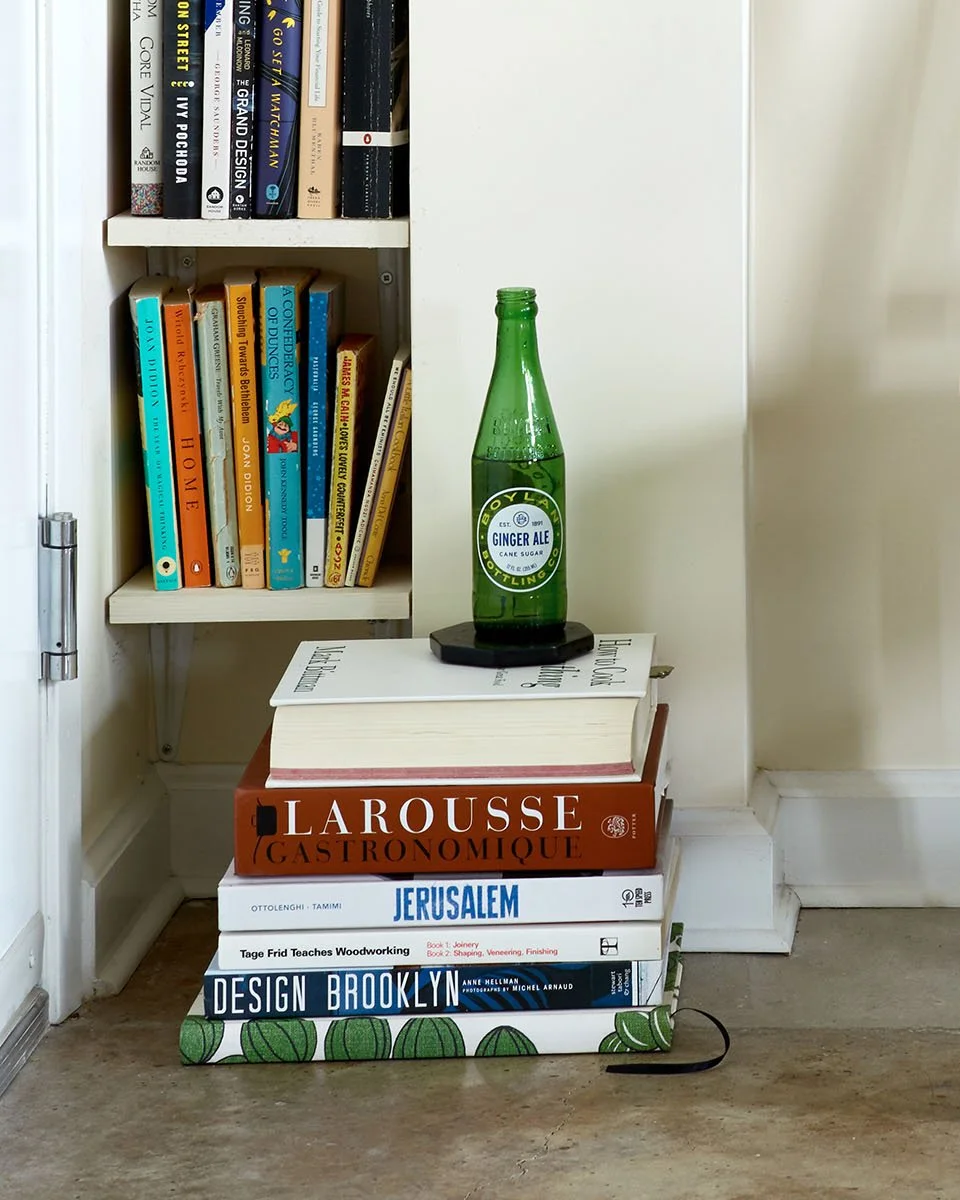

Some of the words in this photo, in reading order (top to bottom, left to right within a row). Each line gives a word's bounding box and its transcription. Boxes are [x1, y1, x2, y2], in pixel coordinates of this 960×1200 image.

[176, 23, 189, 72] STREET
[272, 28, 283, 46] GO
[314, 25, 322, 47] Starting
[139, 36, 154, 79] GORE
[271, 50, 283, 75] SET
[271, 78, 281, 87] A
[313, 63, 321, 89] Financial
[140, 84, 154, 131] VIDAL
[176, 97, 189, 119] IVY
[235, 88, 249, 135] GRAND
[269, 93, 281, 169] WATCHMAN
[175, 124, 188, 184] POCHODA
[234, 139, 247, 189] DESIGN
[282, 287, 292, 297] A
[175, 309, 184, 345] Witold
[211, 308, 221, 341] GRAHAM
[236, 296, 246, 338] Slouching
[267, 306, 279, 324] OF
[145, 318, 155, 352] JOAN
[282, 299, 295, 396] CONFEDERACY
[213, 342, 221, 371] GREENE
[238, 340, 249, 376] Towards
[267, 326, 279, 380] DUNCES
[148, 359, 160, 408] DIDION
[176, 351, 189, 413] Rybczynski
[341, 356, 352, 386] JAMES
[240, 379, 250, 424] Bethlehem
[341, 388, 350, 399] M.
[388, 377, 398, 401] SHOULD
[340, 400, 350, 424] CAIN
[242, 438, 250, 468] JOAN
[376, 424, 387, 456] FEMINISTS
[387, 430, 404, 473] Cookbook
[181, 437, 199, 511] HOME
[279, 458, 287, 477] JOHN
[338, 453, 348, 481] LOVELY
[367, 459, 379, 497] CHIMAMANDA
[156, 474, 164, 508] MAGICAL
[243, 473, 253, 512] DIDION
[335, 482, 346, 535] COUNTERFEIT
[481, 492, 560, 526] BOYLAN
[159, 511, 168, 551] THINKING
[492, 532, 530, 547] GINGER
[533, 530, 550, 546] ALE
[482, 550, 546, 586] BOTTLING
[308, 645, 347, 665] Mark
[594, 657, 621, 666] to
[598, 638, 632, 657] How
[294, 665, 337, 693] Bittman
[591, 666, 627, 686] Cook
[283, 795, 582, 836] LAROUSSE
[266, 836, 583, 865] GASTRONOMIQUE
[251, 903, 305, 912] OTTOLENGHI
[312, 902, 342, 910] TAMIMI
[393, 884, 519, 922] JERUSALEM
[240, 949, 264, 959] Tage
[267, 948, 288, 958] Frid
[291, 947, 333, 957] Teaches
[335, 946, 410, 957] Woodworking
[427, 941, 444, 949] Book
[453, 940, 479, 949] Joinery
[453, 948, 485, 958] Shaping,
[486, 948, 522, 957] Veneering,
[525, 947, 558, 957] Finishing
[213, 975, 306, 1015] DESIGN
[327, 970, 459, 1011] BROOKLYN
[462, 978, 482, 986] ANNE
[485, 977, 519, 985] HELLMAN
[512, 983, 540, 991] MICHEL
[543, 983, 574, 991] ARNAUD
